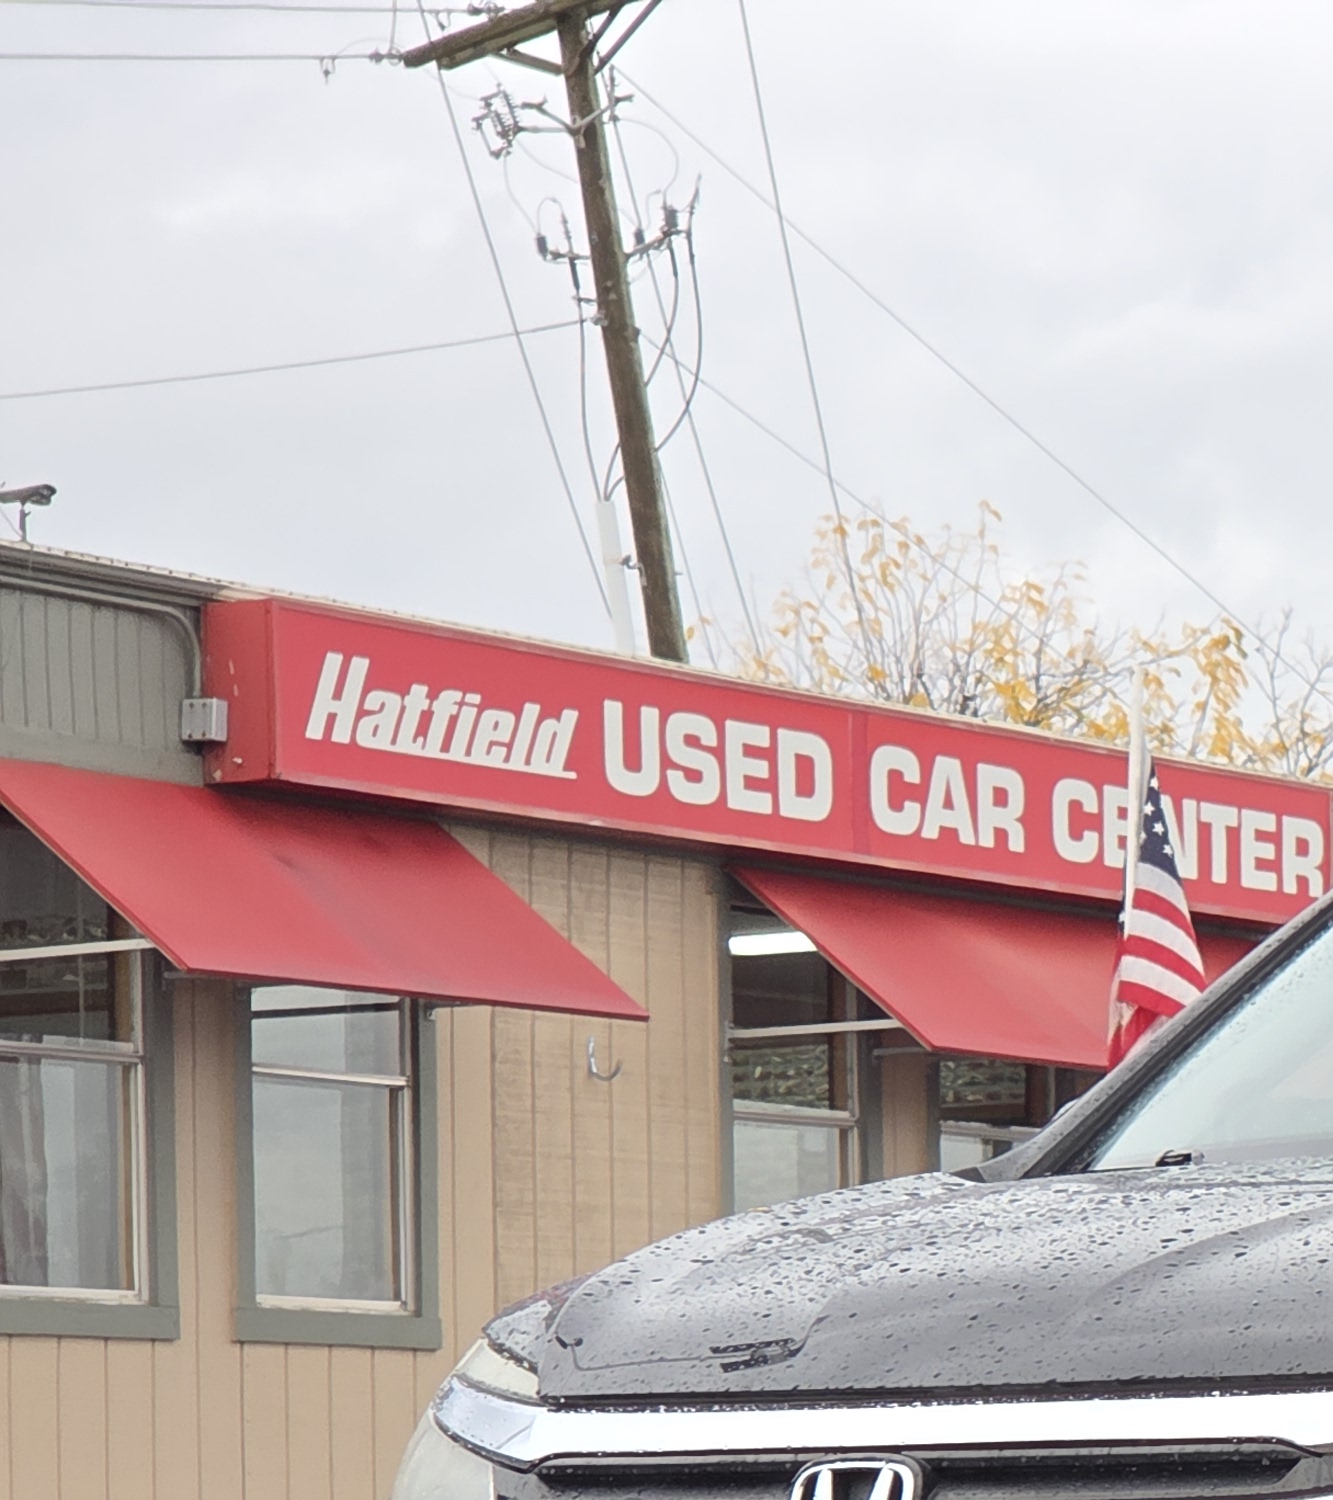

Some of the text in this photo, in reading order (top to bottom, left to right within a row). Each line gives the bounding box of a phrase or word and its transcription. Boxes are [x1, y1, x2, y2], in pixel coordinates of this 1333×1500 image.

[304, 651, 1325, 898] Hatfield USED CAR CENTER
